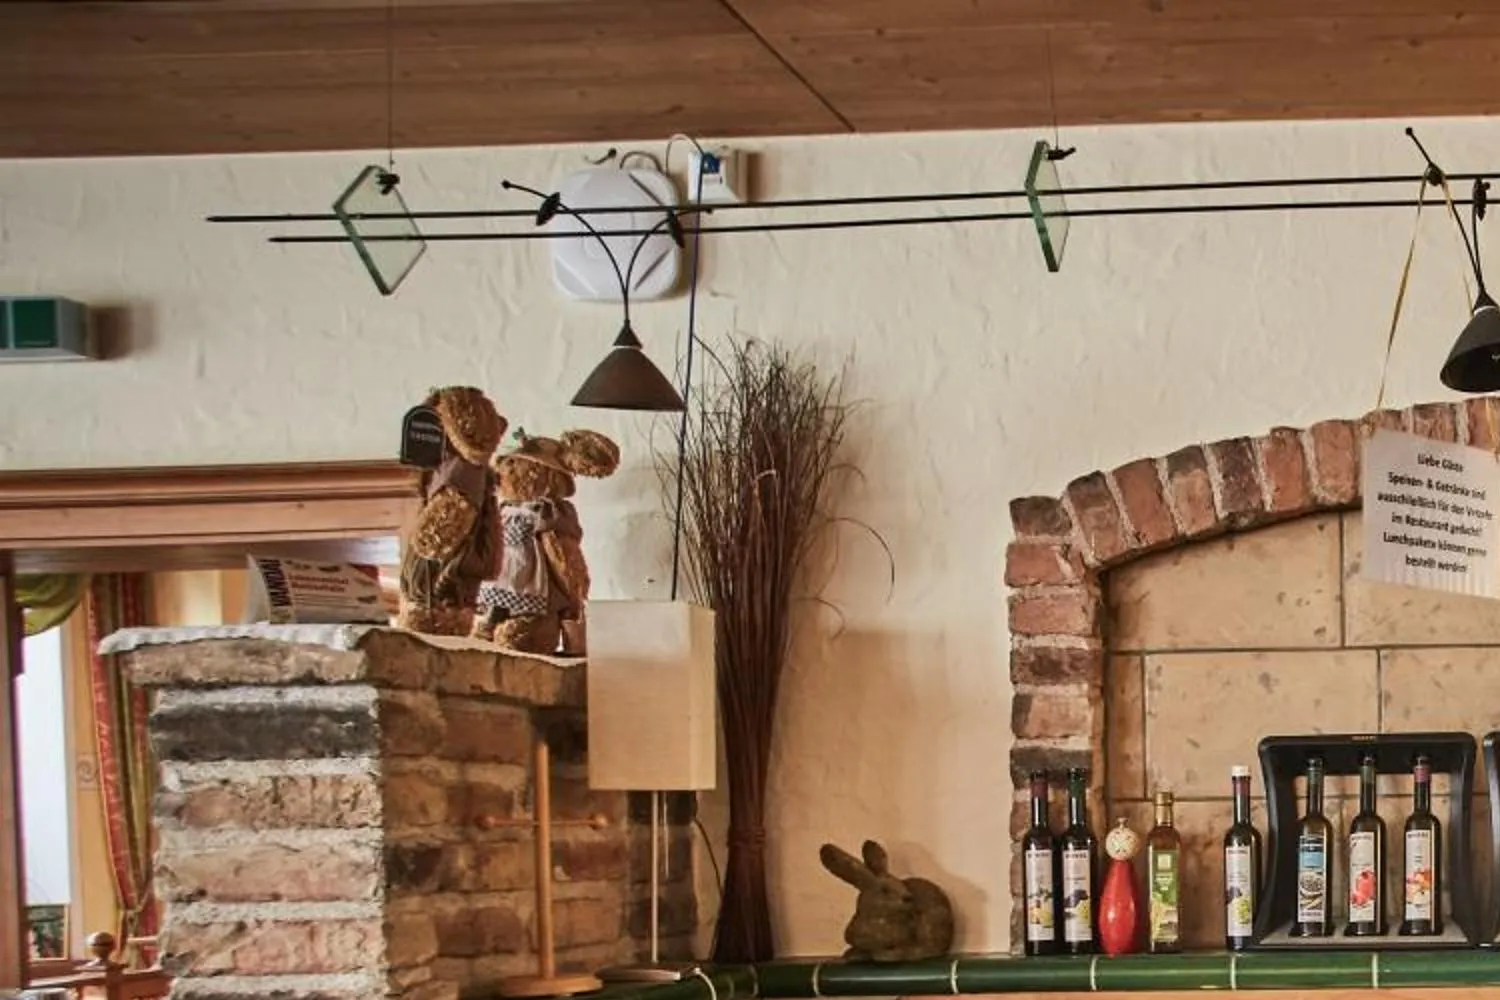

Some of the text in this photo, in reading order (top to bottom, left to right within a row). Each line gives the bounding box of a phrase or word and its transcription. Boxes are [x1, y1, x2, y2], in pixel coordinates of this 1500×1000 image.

[1417, 453, 1440, 468] Liebe
[1427, 478, 1433, 490] &
[1391, 511, 1402, 523] im
[1405, 515, 1449, 531] Restaurant
[1438, 540, 1466, 553] können
[1405, 553, 1436, 569] bestellt
